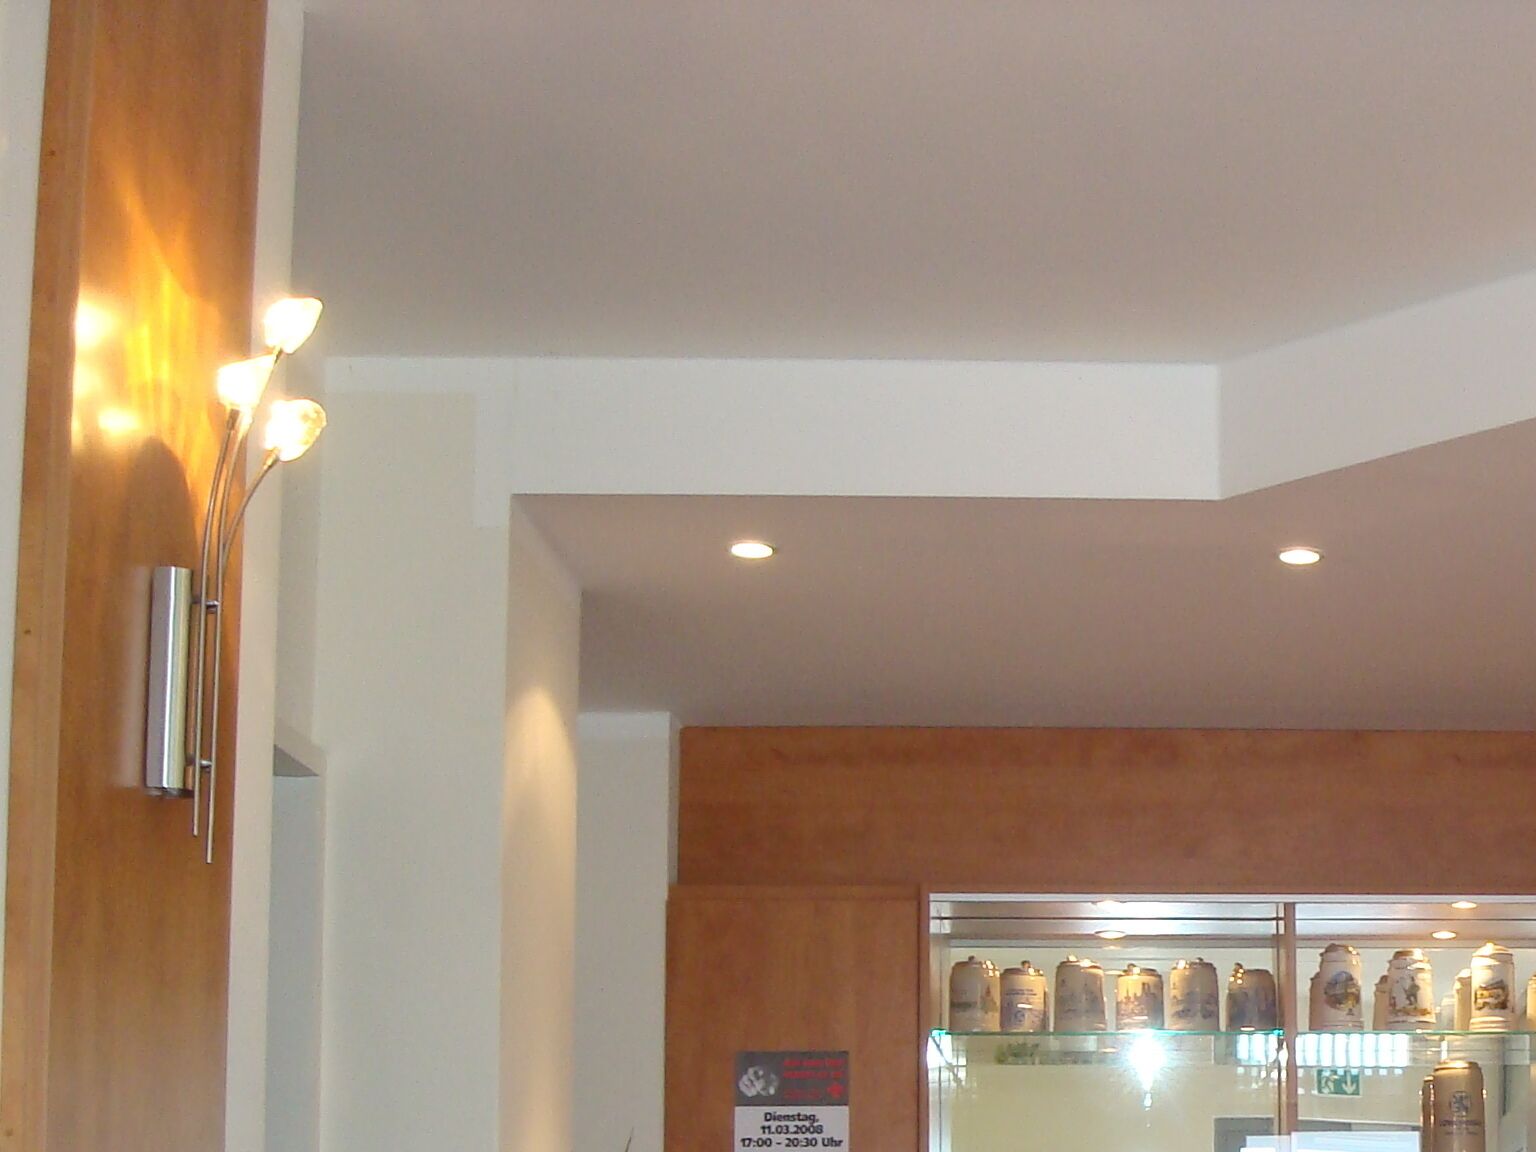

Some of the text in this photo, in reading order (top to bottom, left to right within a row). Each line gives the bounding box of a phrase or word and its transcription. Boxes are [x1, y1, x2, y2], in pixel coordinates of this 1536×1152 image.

[764, 1111, 819, 1124] Dienstag,
[760, 1124, 824, 1134] 11.03.2008
[740, 1137, 772, 1147] 17:00
[784, 1137, 818, 1147] 20:30
[821, 1136, 844, 1147] Uhr
